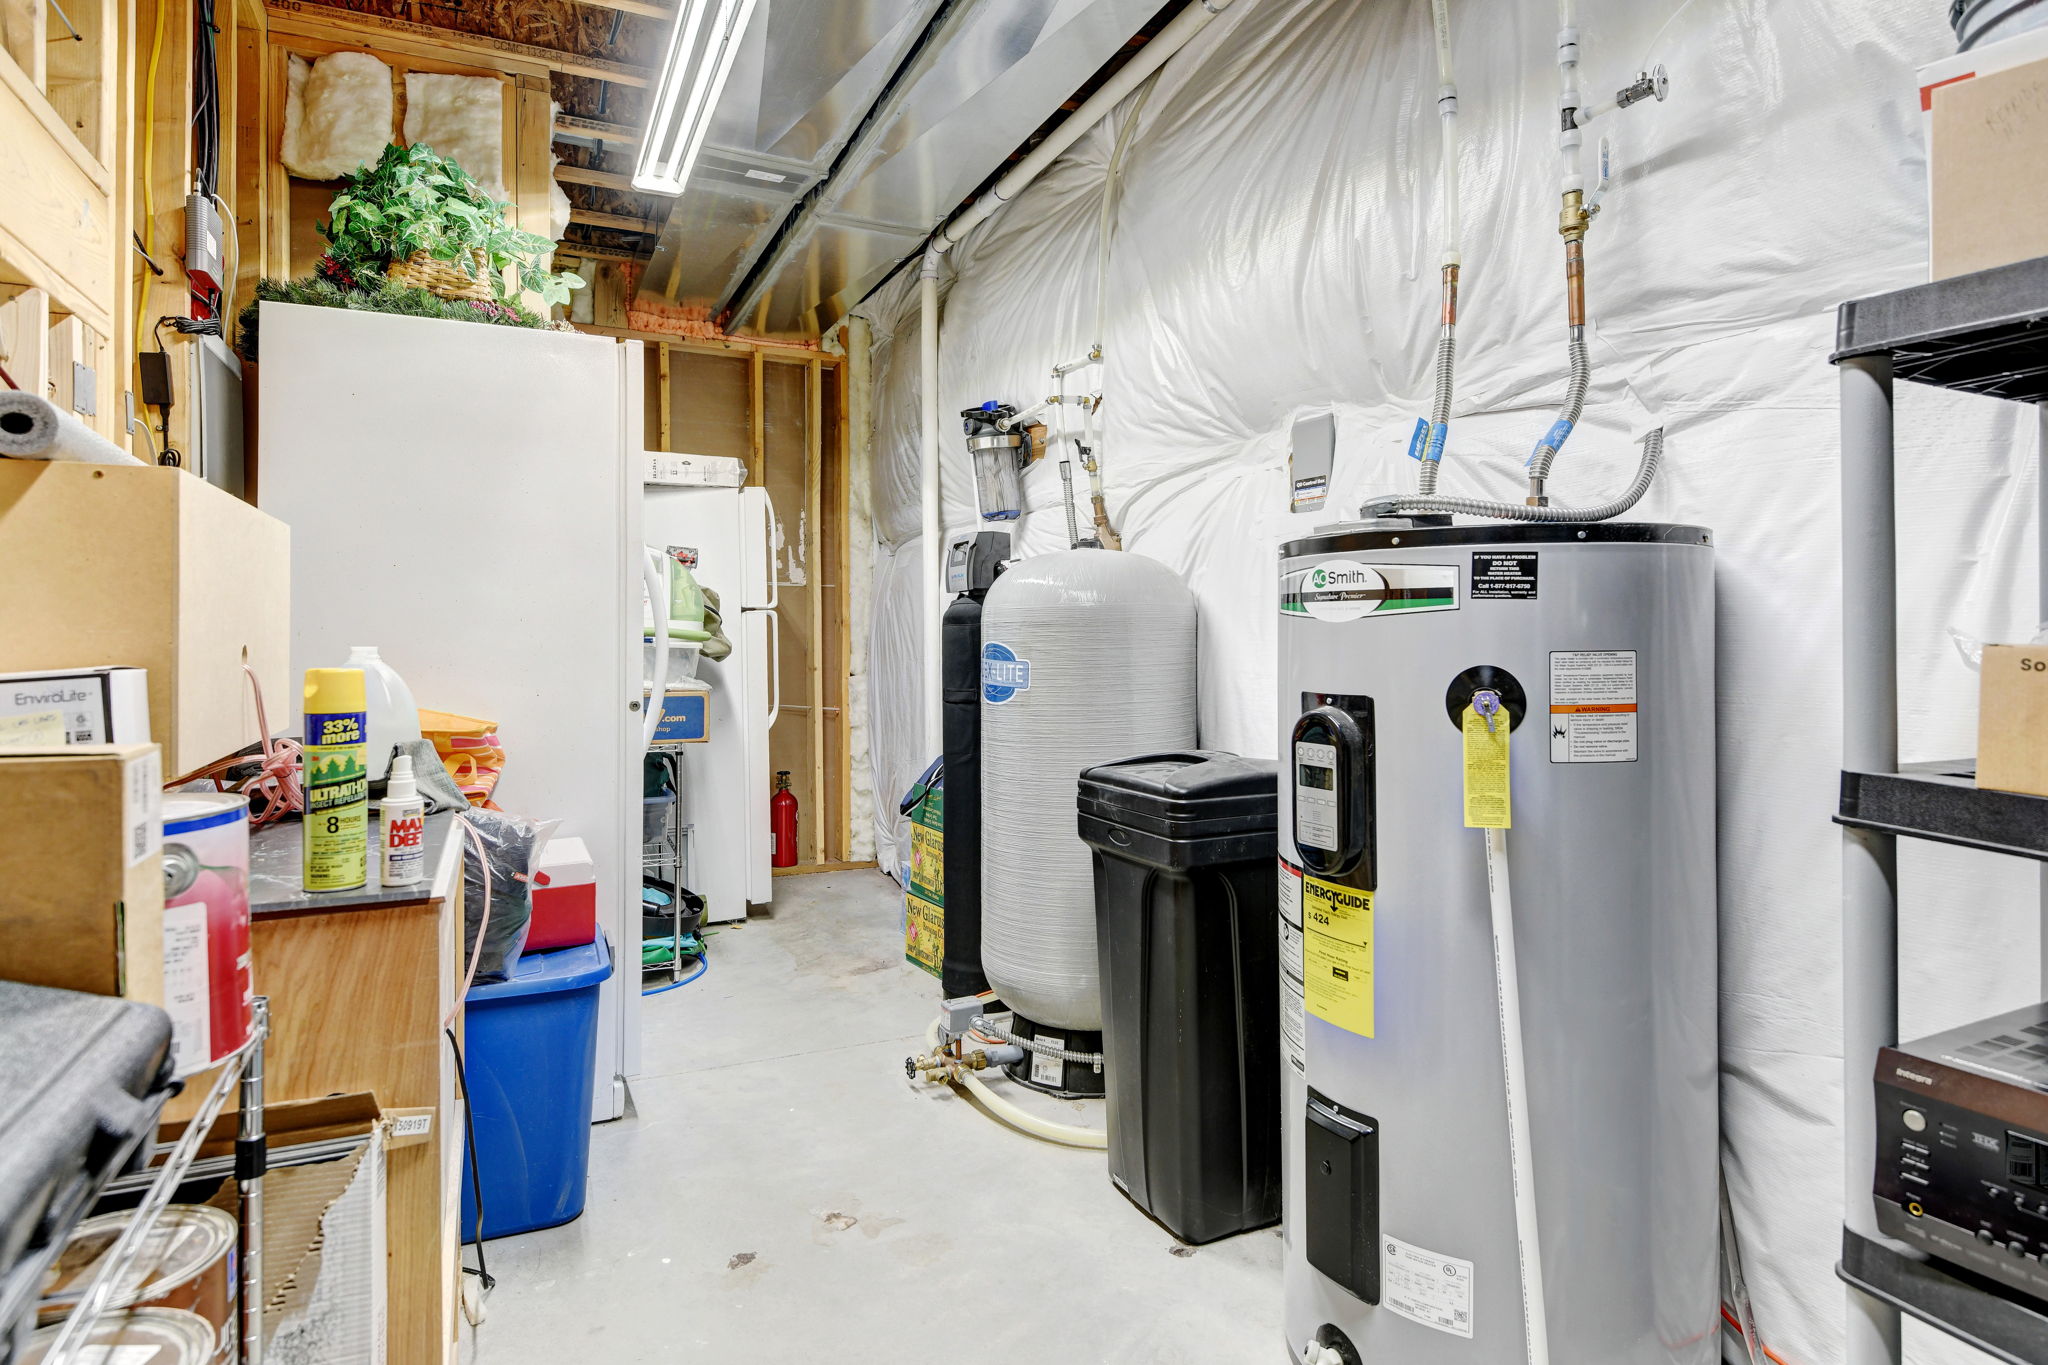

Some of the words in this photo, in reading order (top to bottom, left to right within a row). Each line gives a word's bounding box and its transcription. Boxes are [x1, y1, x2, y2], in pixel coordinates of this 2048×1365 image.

[493, 39, 523, 55] CCMC
[1328, 570, 1365, 584] Smith
[14, 689, 87, 706] EnviroLite
[323, 717, 359, 734] 33%
[321, 730, 360, 745] more
[326, 816, 340, 834] 8
[1305, 881, 1370, 911] ENERGYGUIDE
[907, 897, 922, 917] New
[922, 904, 944, 929] Glarus
[1313, 912, 1330, 927] 424
[1896, 1067, 1933, 1086] Integra
